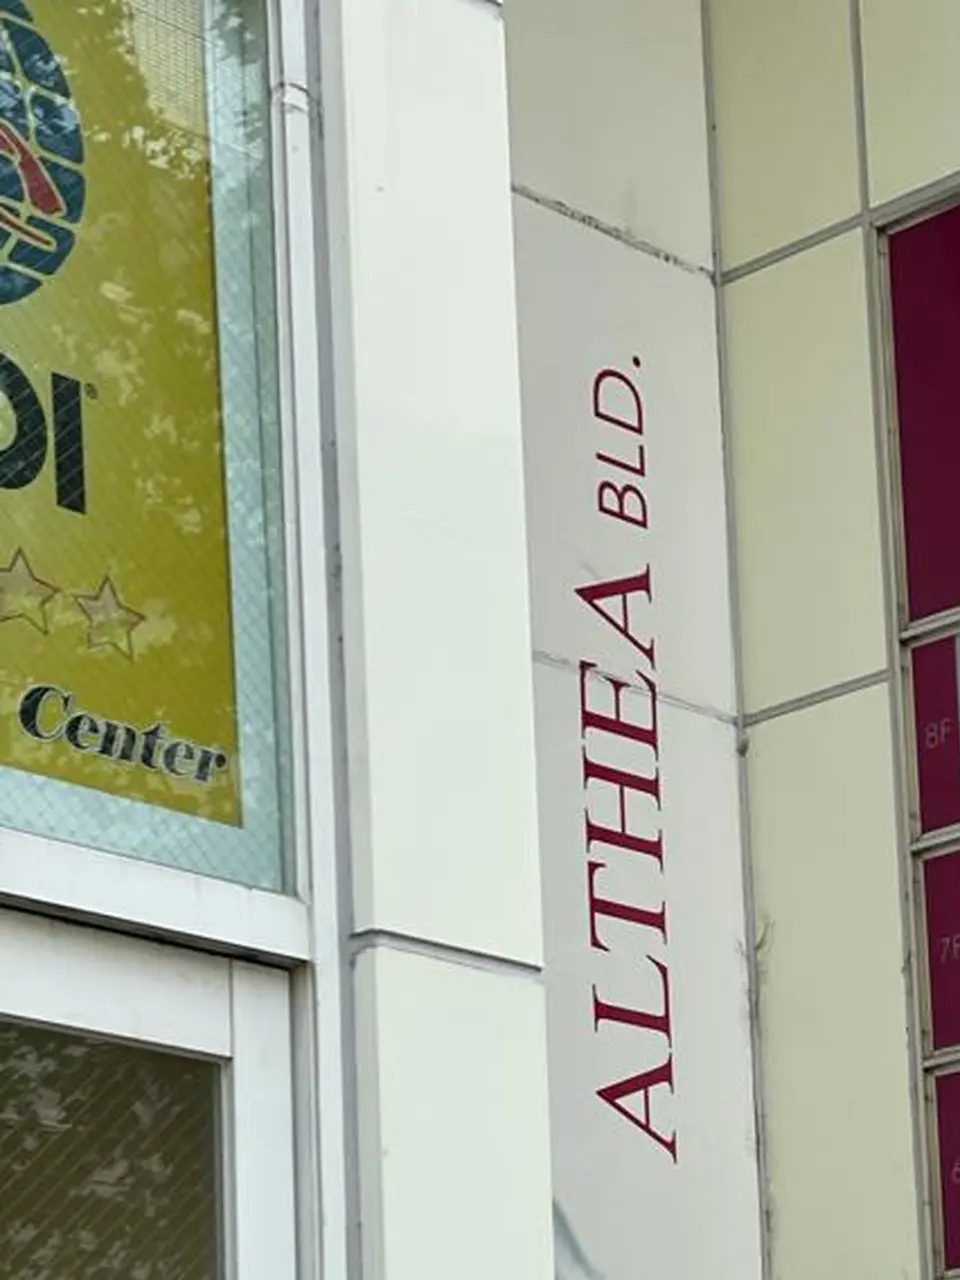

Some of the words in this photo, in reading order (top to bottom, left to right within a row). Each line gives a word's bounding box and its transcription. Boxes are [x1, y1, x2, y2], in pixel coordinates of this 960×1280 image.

[592, 355, 649, 530] BLD.
[17, 684, 228, 783] Center
[923, 718, 953, 749] 8F
[574, 562, 677, 1164] ALTHEA
